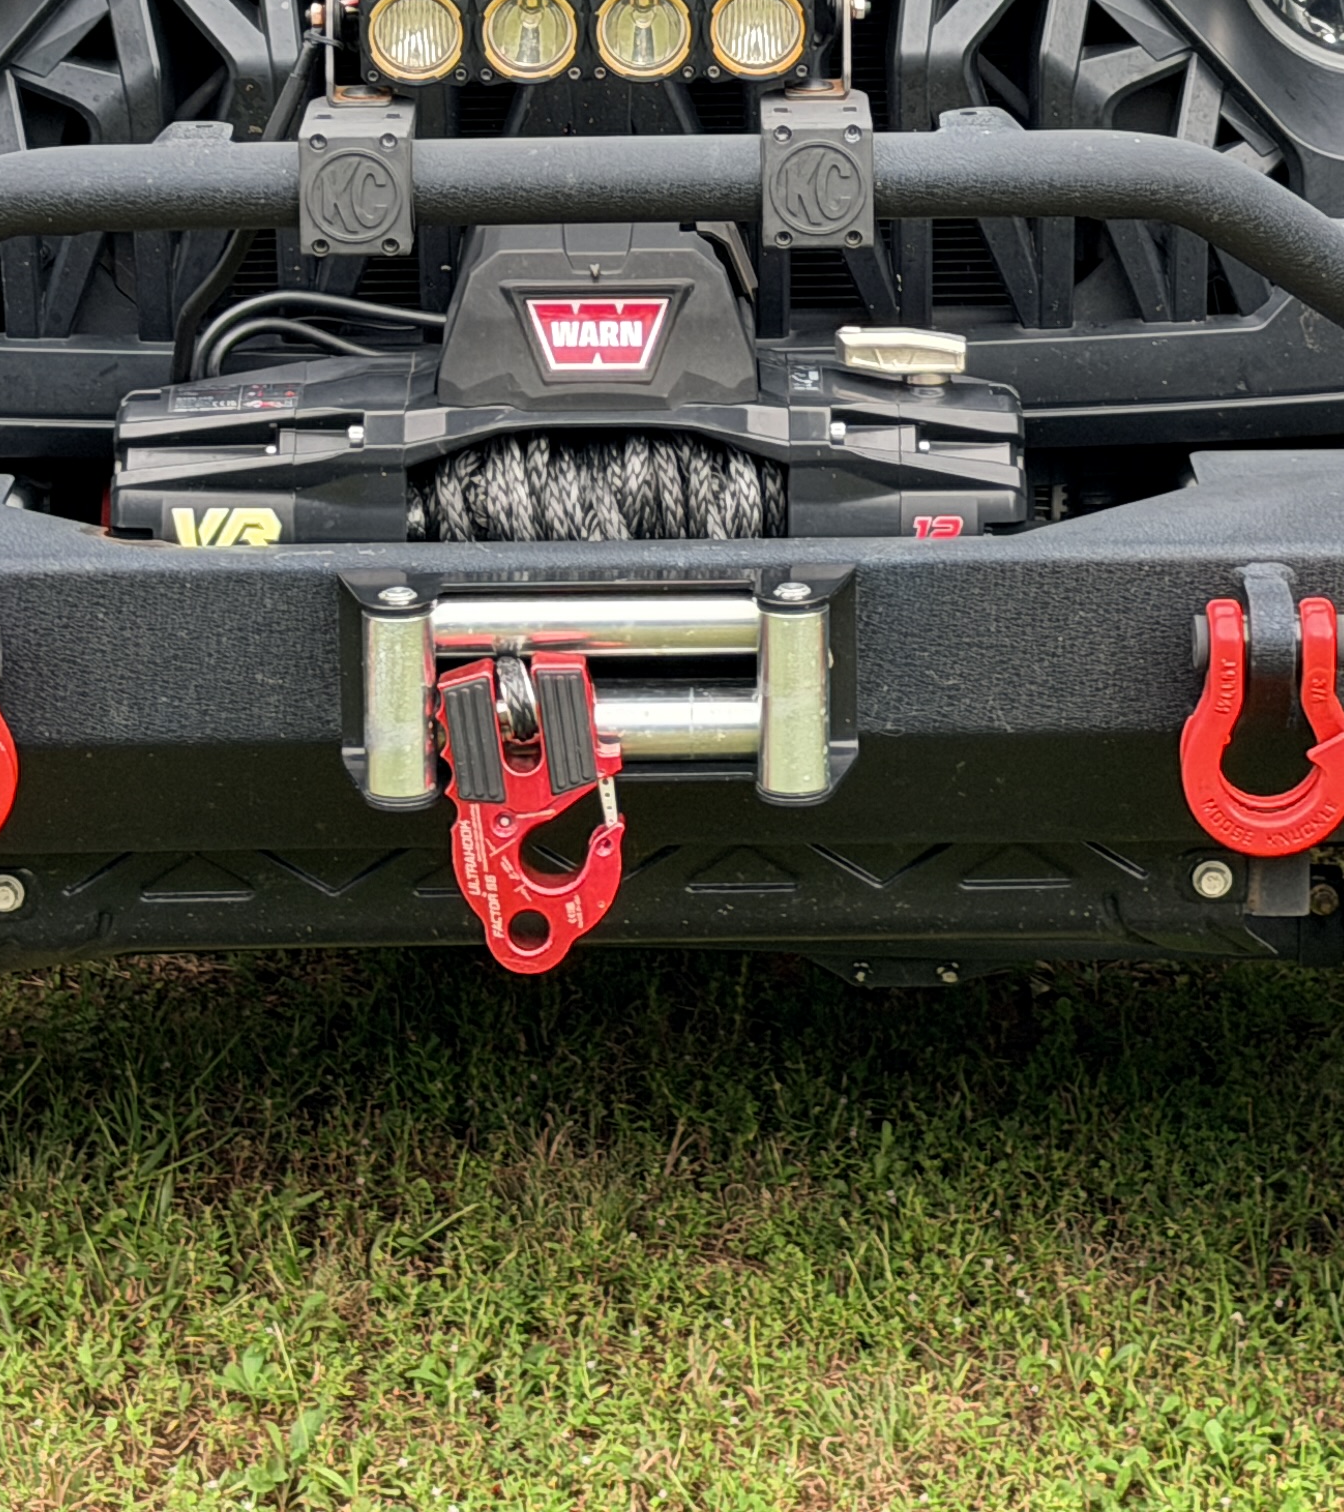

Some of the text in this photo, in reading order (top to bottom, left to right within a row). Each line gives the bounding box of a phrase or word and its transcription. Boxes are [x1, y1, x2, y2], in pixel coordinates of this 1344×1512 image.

[317, 157, 388, 235] KC
[780, 148, 853, 226] KC
[550, 320, 643, 348] WARN
[171, 507, 283, 547] VR
[912, 514, 964, 541] 12
[1200, 797, 1256, 847] MOOSE
[458, 819, 482, 897] ULTRAHOOK
[487, 892, 505, 939] FACTOR
